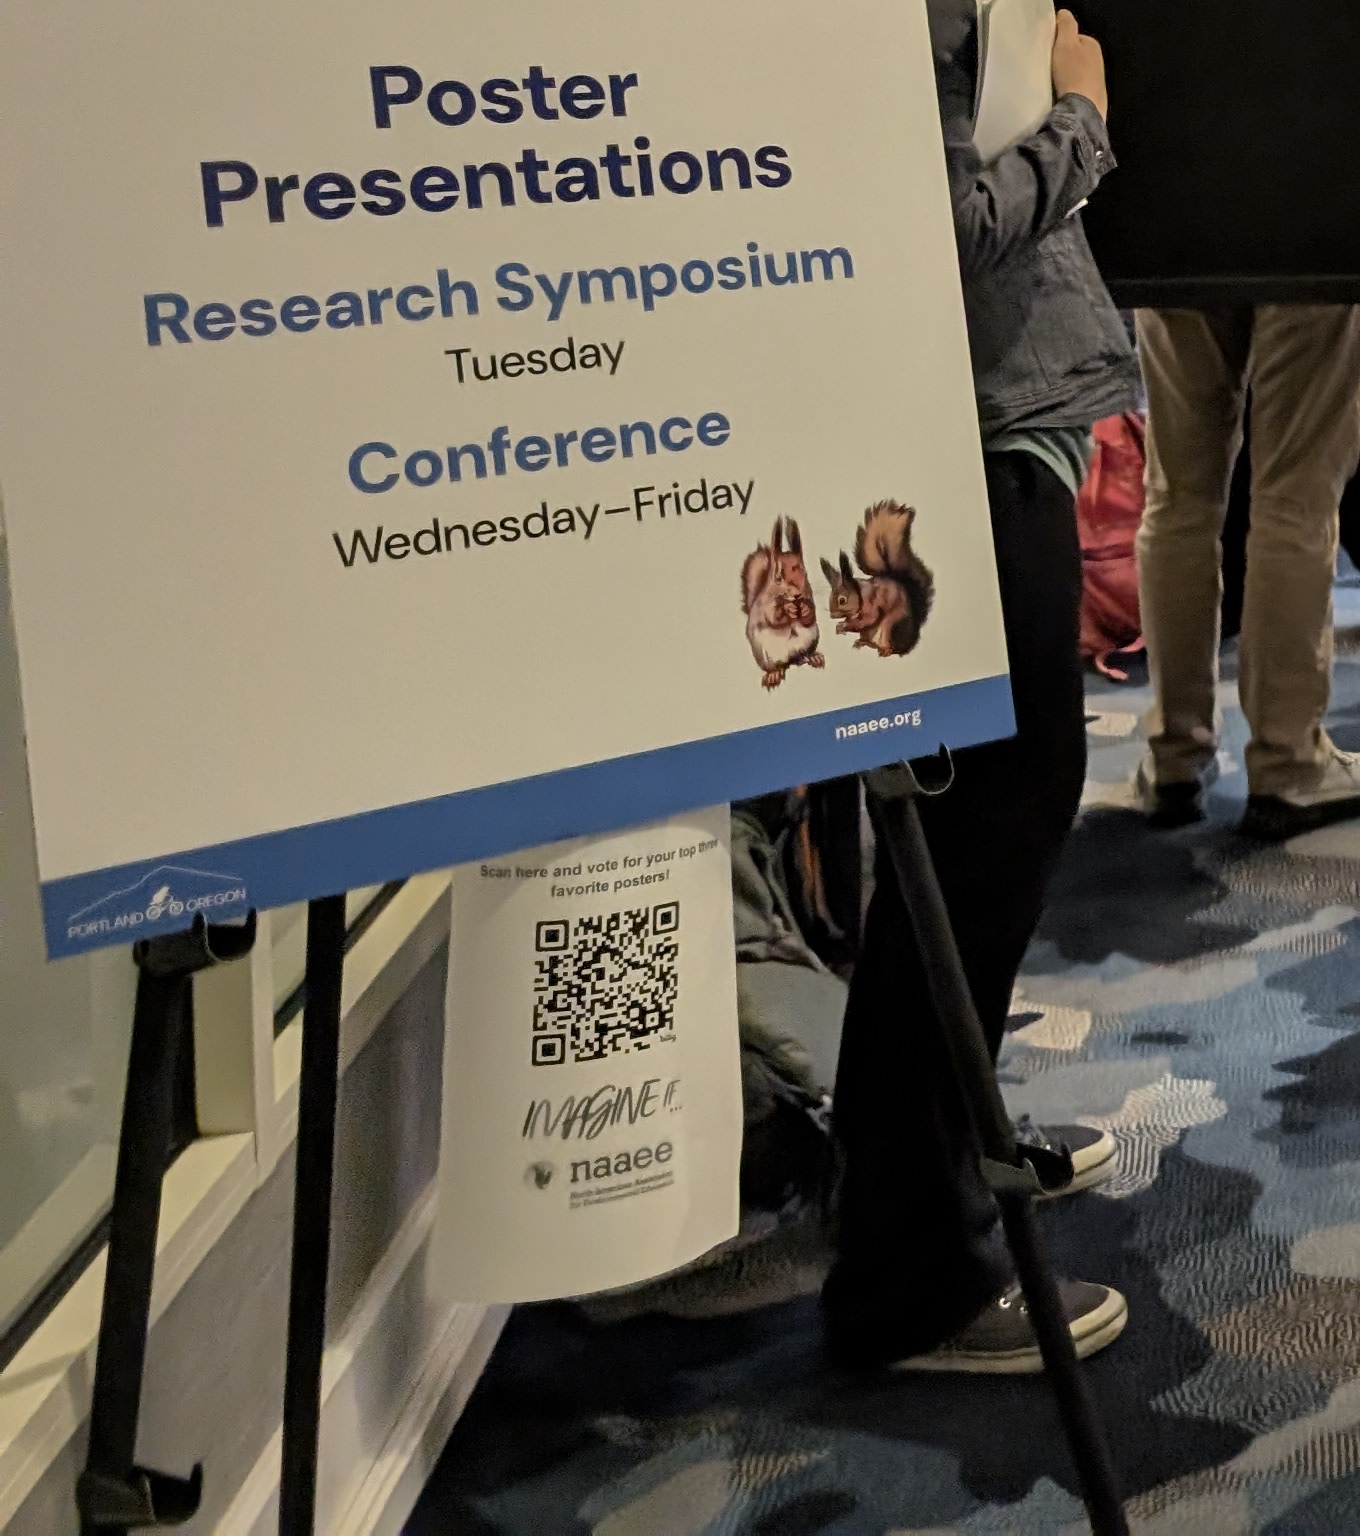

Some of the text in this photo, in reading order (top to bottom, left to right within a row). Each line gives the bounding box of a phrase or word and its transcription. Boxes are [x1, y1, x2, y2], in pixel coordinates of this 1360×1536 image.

[370, 65, 639, 129] Poster
[200, 136, 792, 228] Presentations
[143, 241, 855, 347] Research Symposium
[445, 337, 626, 385] Tuesday
[348, 410, 732, 495] Conference
[835, 709, 922, 740] naaee.org
[480, 865, 511, 879] Scan
[515, 865, 548, 879] here
[553, 863, 582, 877] and
[587, 860, 619, 875] vote
[623, 854, 642, 869] for
[646, 850, 676, 866] your
[679, 844, 696, 859] top
[551, 870, 670, 898] favorite posters!
[67, 888, 246, 938] PORTLAND OREGON
[522, 1078, 661, 1140] IMAGINE
[570, 1142, 673, 1183] naaee
